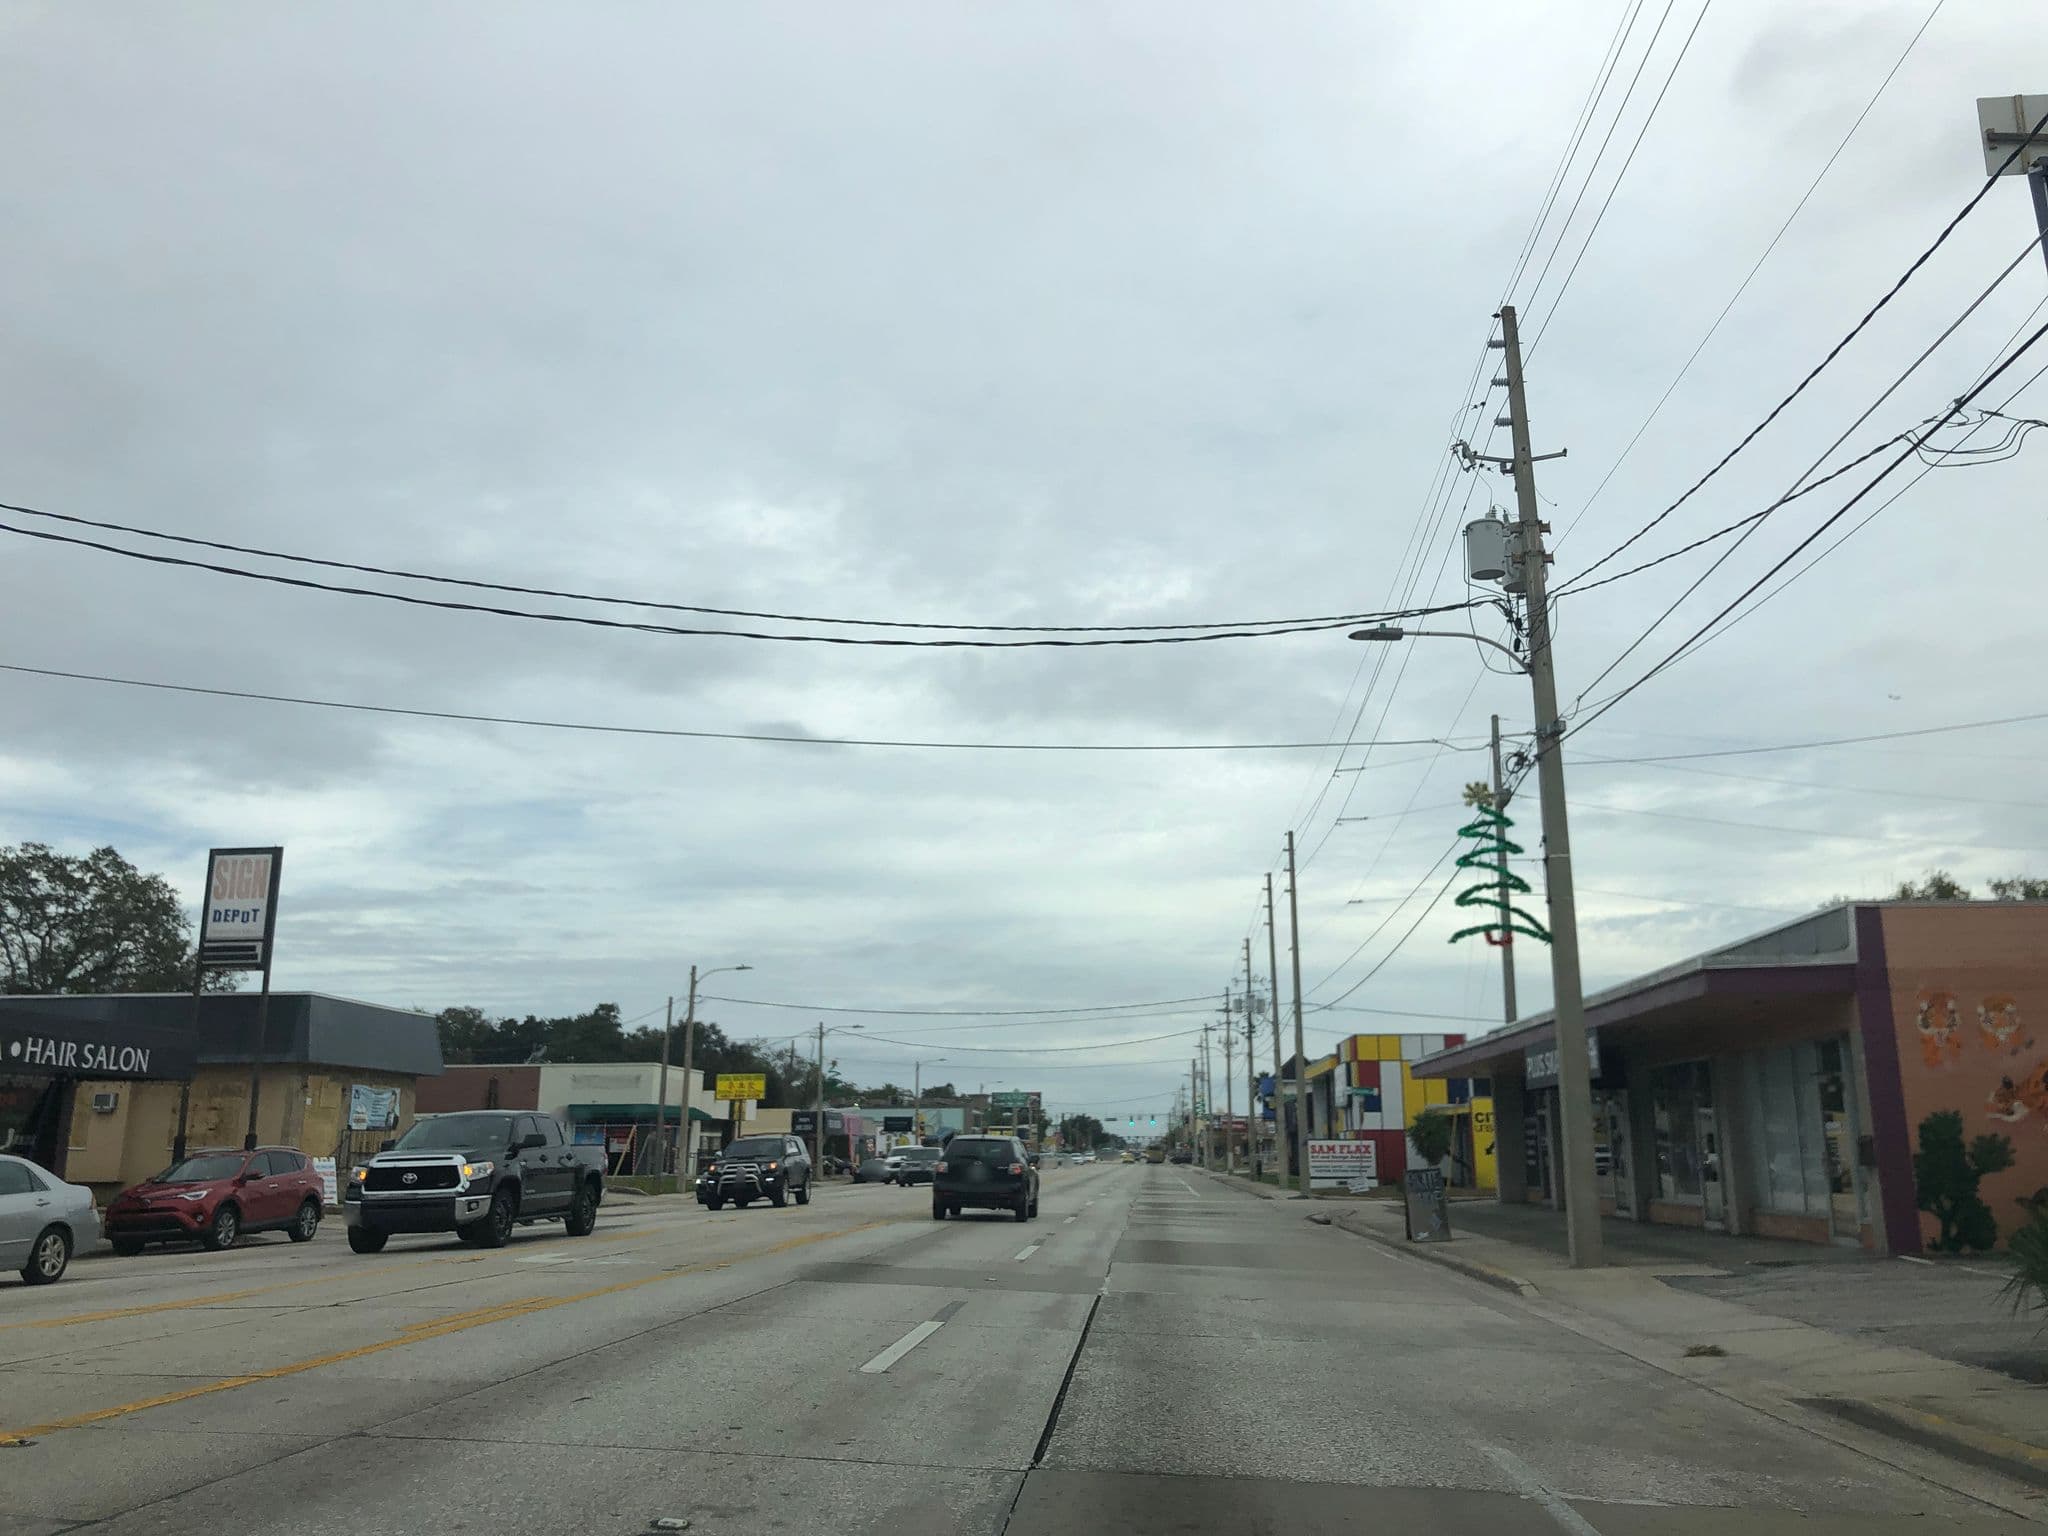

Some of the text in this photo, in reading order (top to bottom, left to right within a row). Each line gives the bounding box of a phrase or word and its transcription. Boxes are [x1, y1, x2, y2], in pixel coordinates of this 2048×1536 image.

[213, 858, 269, 900] SIGN
[212, 908, 260, 923] DEPOT
[24, 1036, 77, 1068] HAIR
[81, 1043, 150, 1073] SALON
[1311, 1144, 1372, 1155] SAM FLAX
